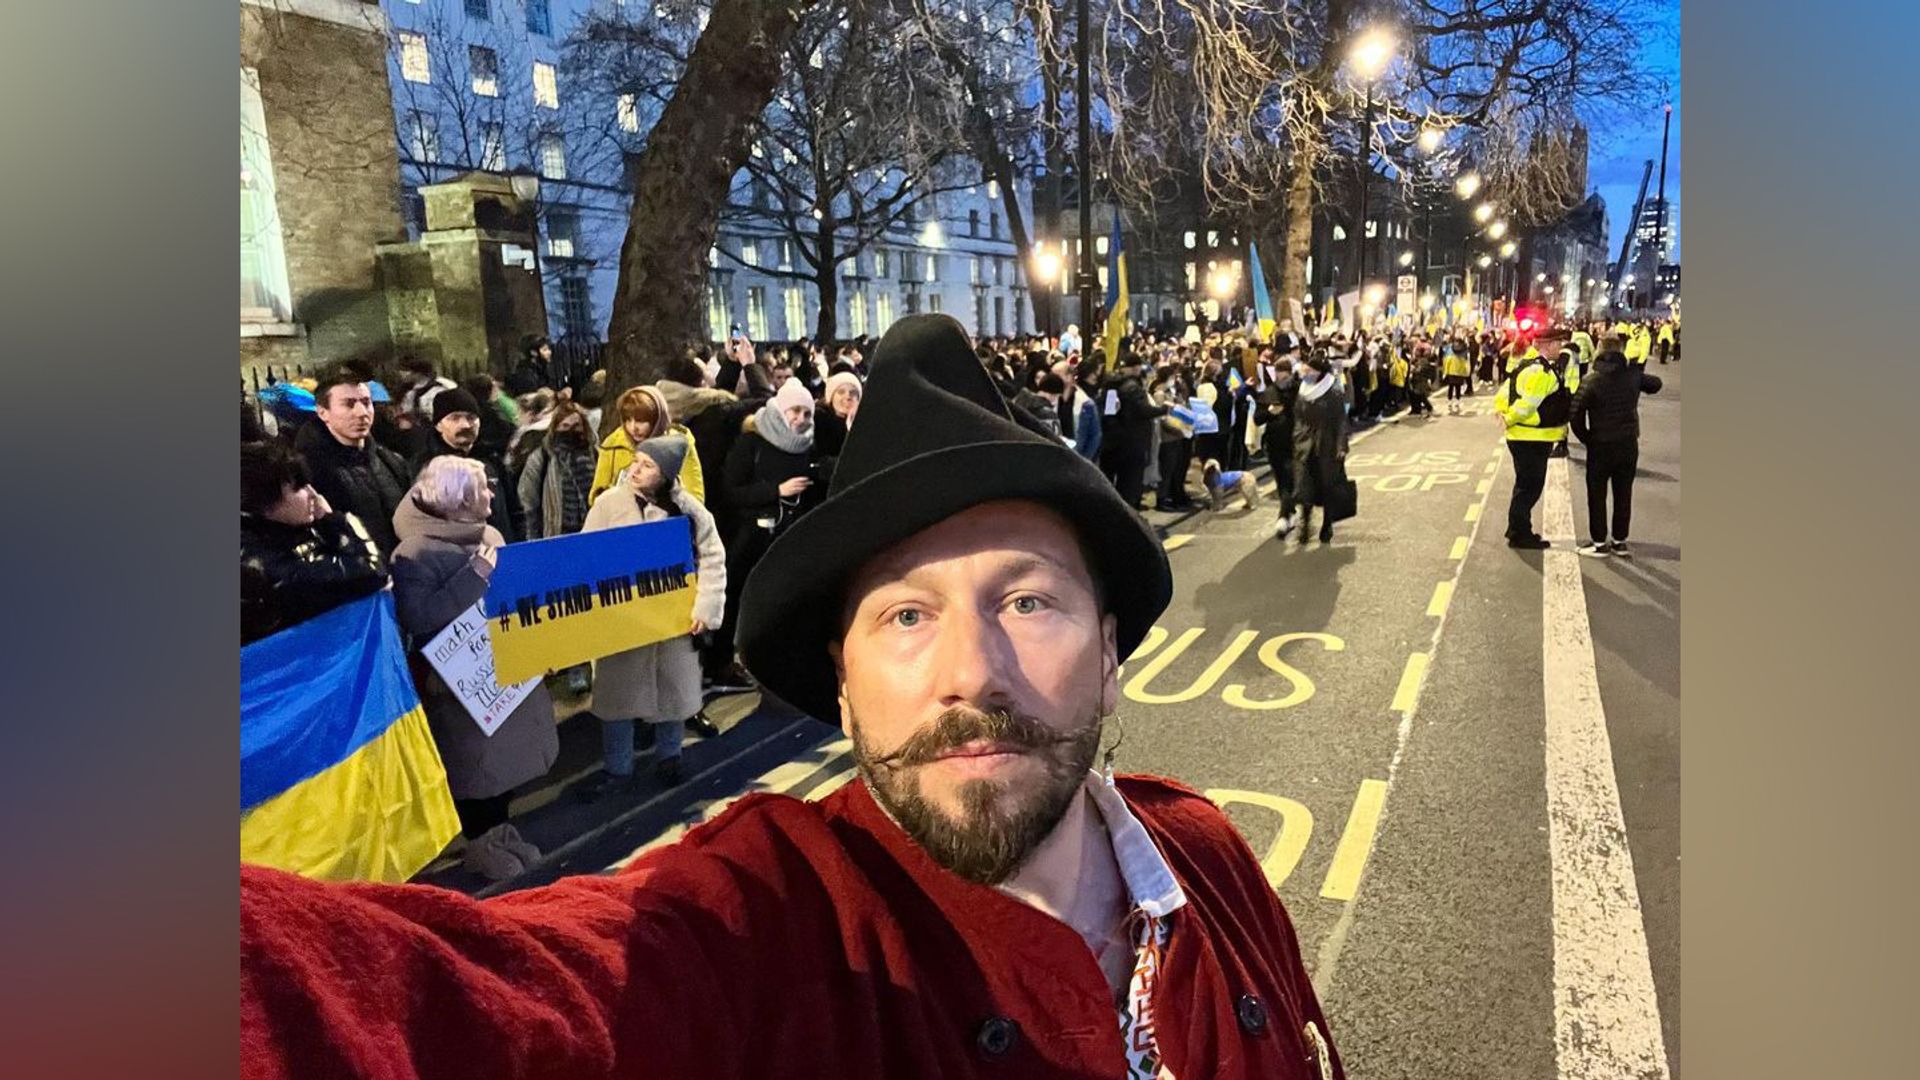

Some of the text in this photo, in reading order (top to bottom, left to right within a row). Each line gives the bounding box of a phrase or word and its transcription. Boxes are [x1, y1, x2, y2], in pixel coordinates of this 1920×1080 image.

[1344, 451, 1461, 467] BUS
[1347, 473, 1469, 491] TOP
[515, 593, 542, 628] WE
[545, 582, 593, 620] STAND
[596, 575, 633, 607] WITH
[635, 563, 689, 598] UKRAINE
